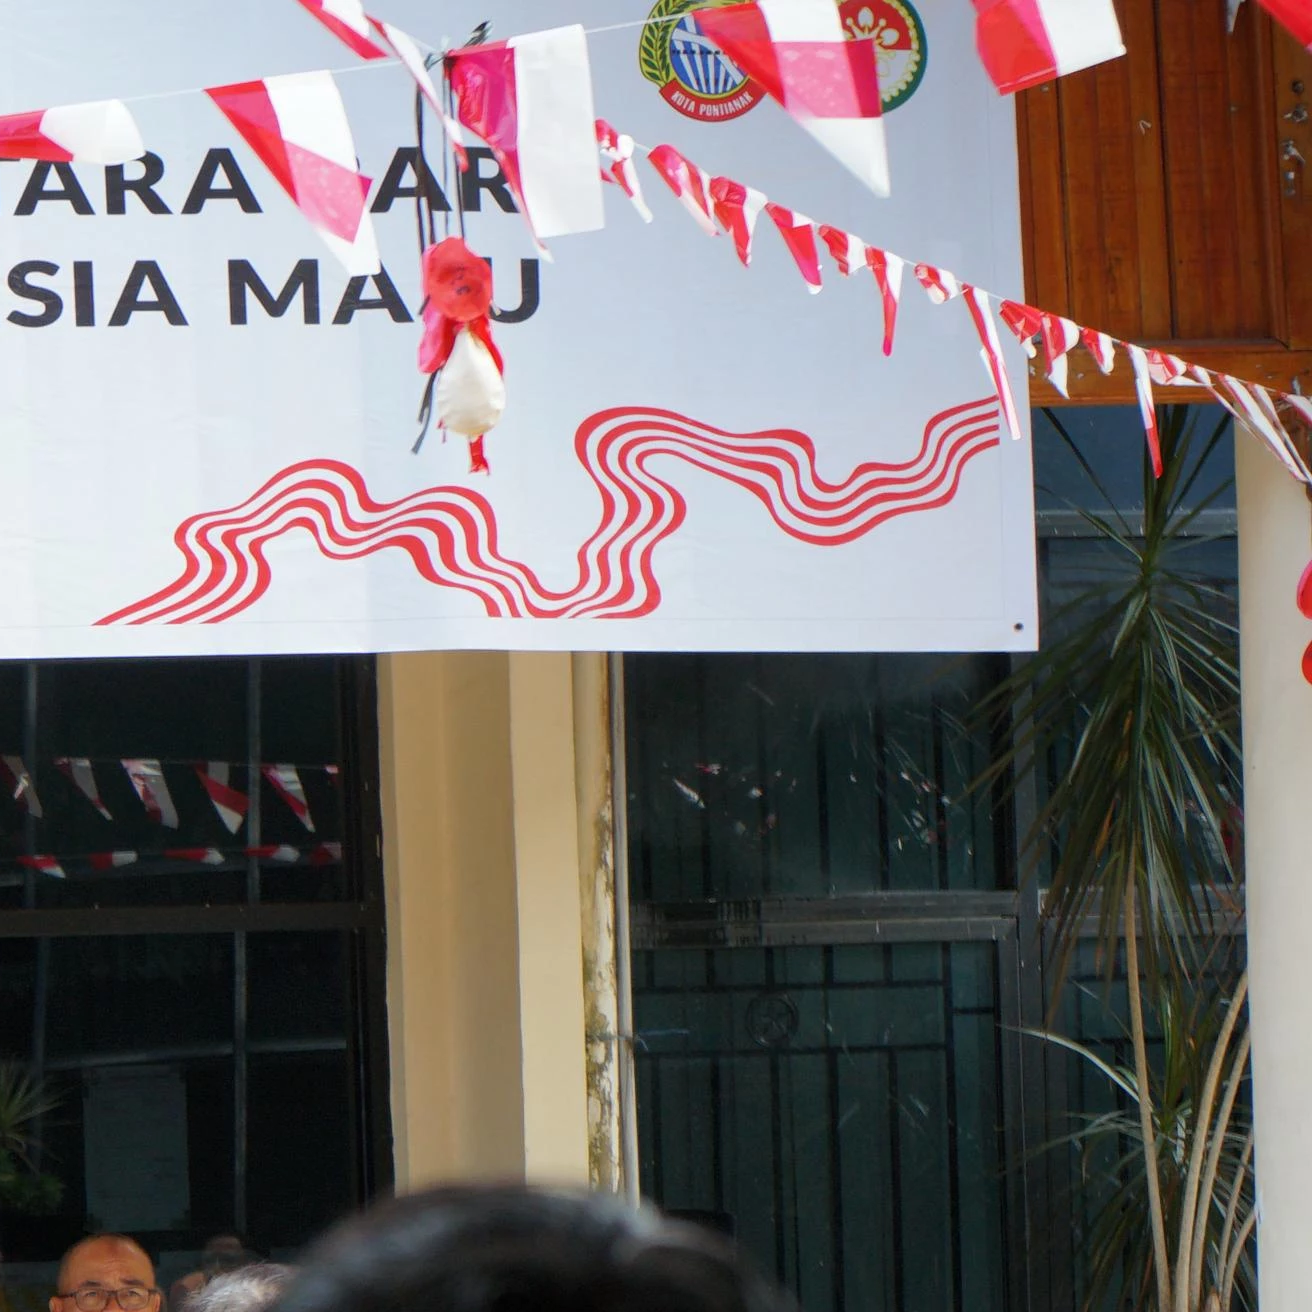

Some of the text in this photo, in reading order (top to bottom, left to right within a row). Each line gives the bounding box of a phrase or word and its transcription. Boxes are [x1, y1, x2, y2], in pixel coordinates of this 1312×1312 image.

[671, 91, 754, 117] KOTA PONTIANAK
[227, 258, 540, 327] MAU
